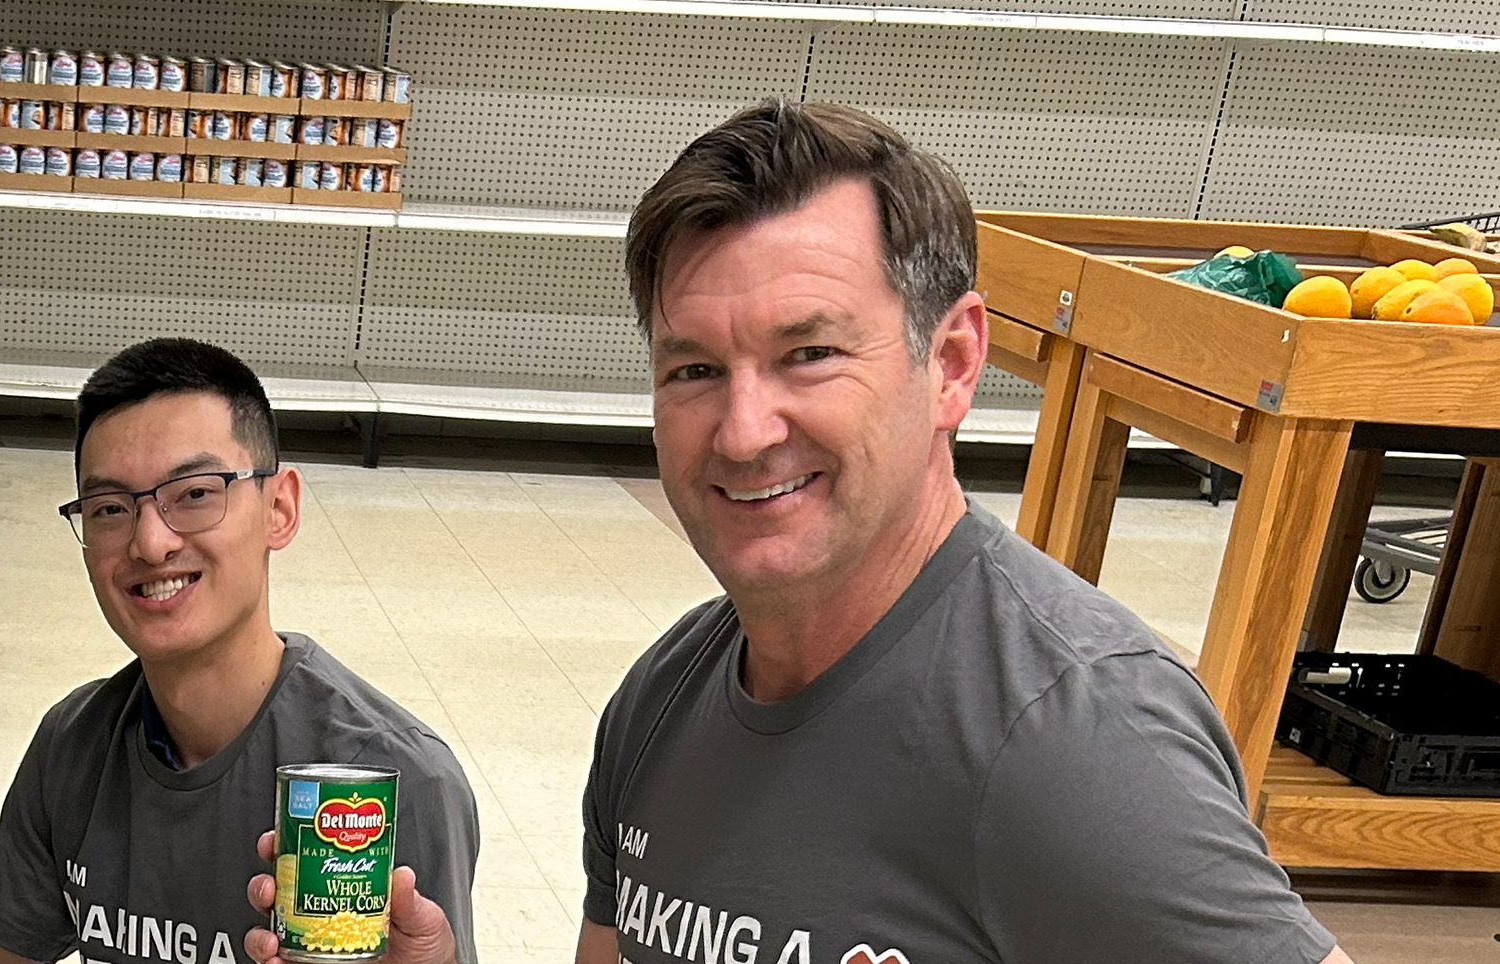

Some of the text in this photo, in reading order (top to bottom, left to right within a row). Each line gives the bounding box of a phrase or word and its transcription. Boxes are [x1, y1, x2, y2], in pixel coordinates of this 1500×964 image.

[292, 802, 313, 810] SALT
[321, 812, 383, 828] Del Monte
[338, 831, 367, 843] Quality
[621, 826, 649, 860] AM
[302, 847, 334, 857] MADE
[326, 879, 372, 897] WHOLE
[303, 893, 385, 912] KERNEL CORN
